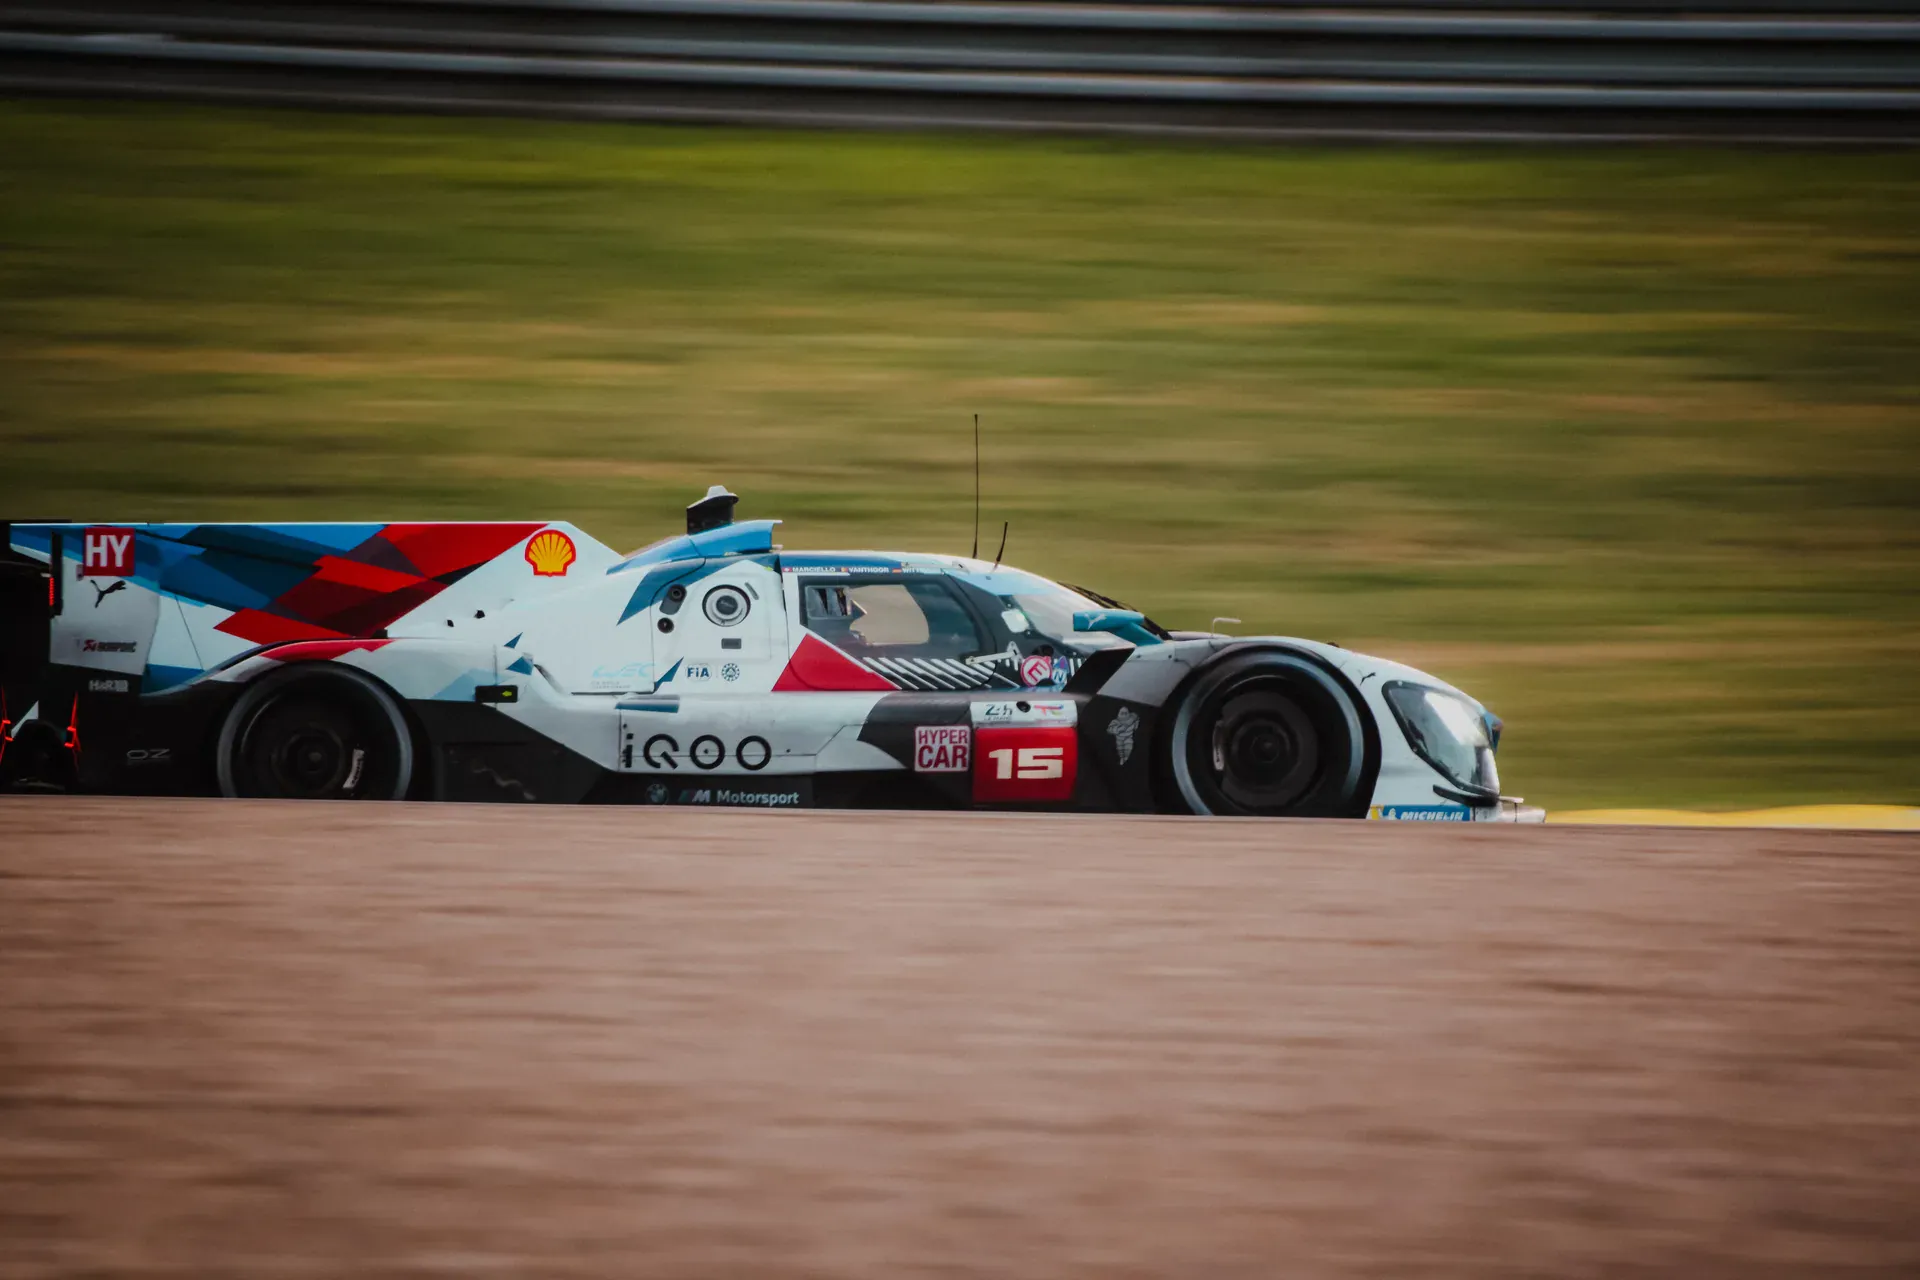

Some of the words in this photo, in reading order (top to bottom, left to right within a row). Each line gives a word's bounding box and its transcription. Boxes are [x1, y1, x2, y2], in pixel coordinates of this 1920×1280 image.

[85, 534, 131, 568] HY
[918, 730, 968, 745] HYPER
[918, 745, 968, 768] CAR
[988, 747, 1064, 780] 15
[716, 790, 800, 806] Motorsport
[1400, 811, 1464, 821] MICHELIN
